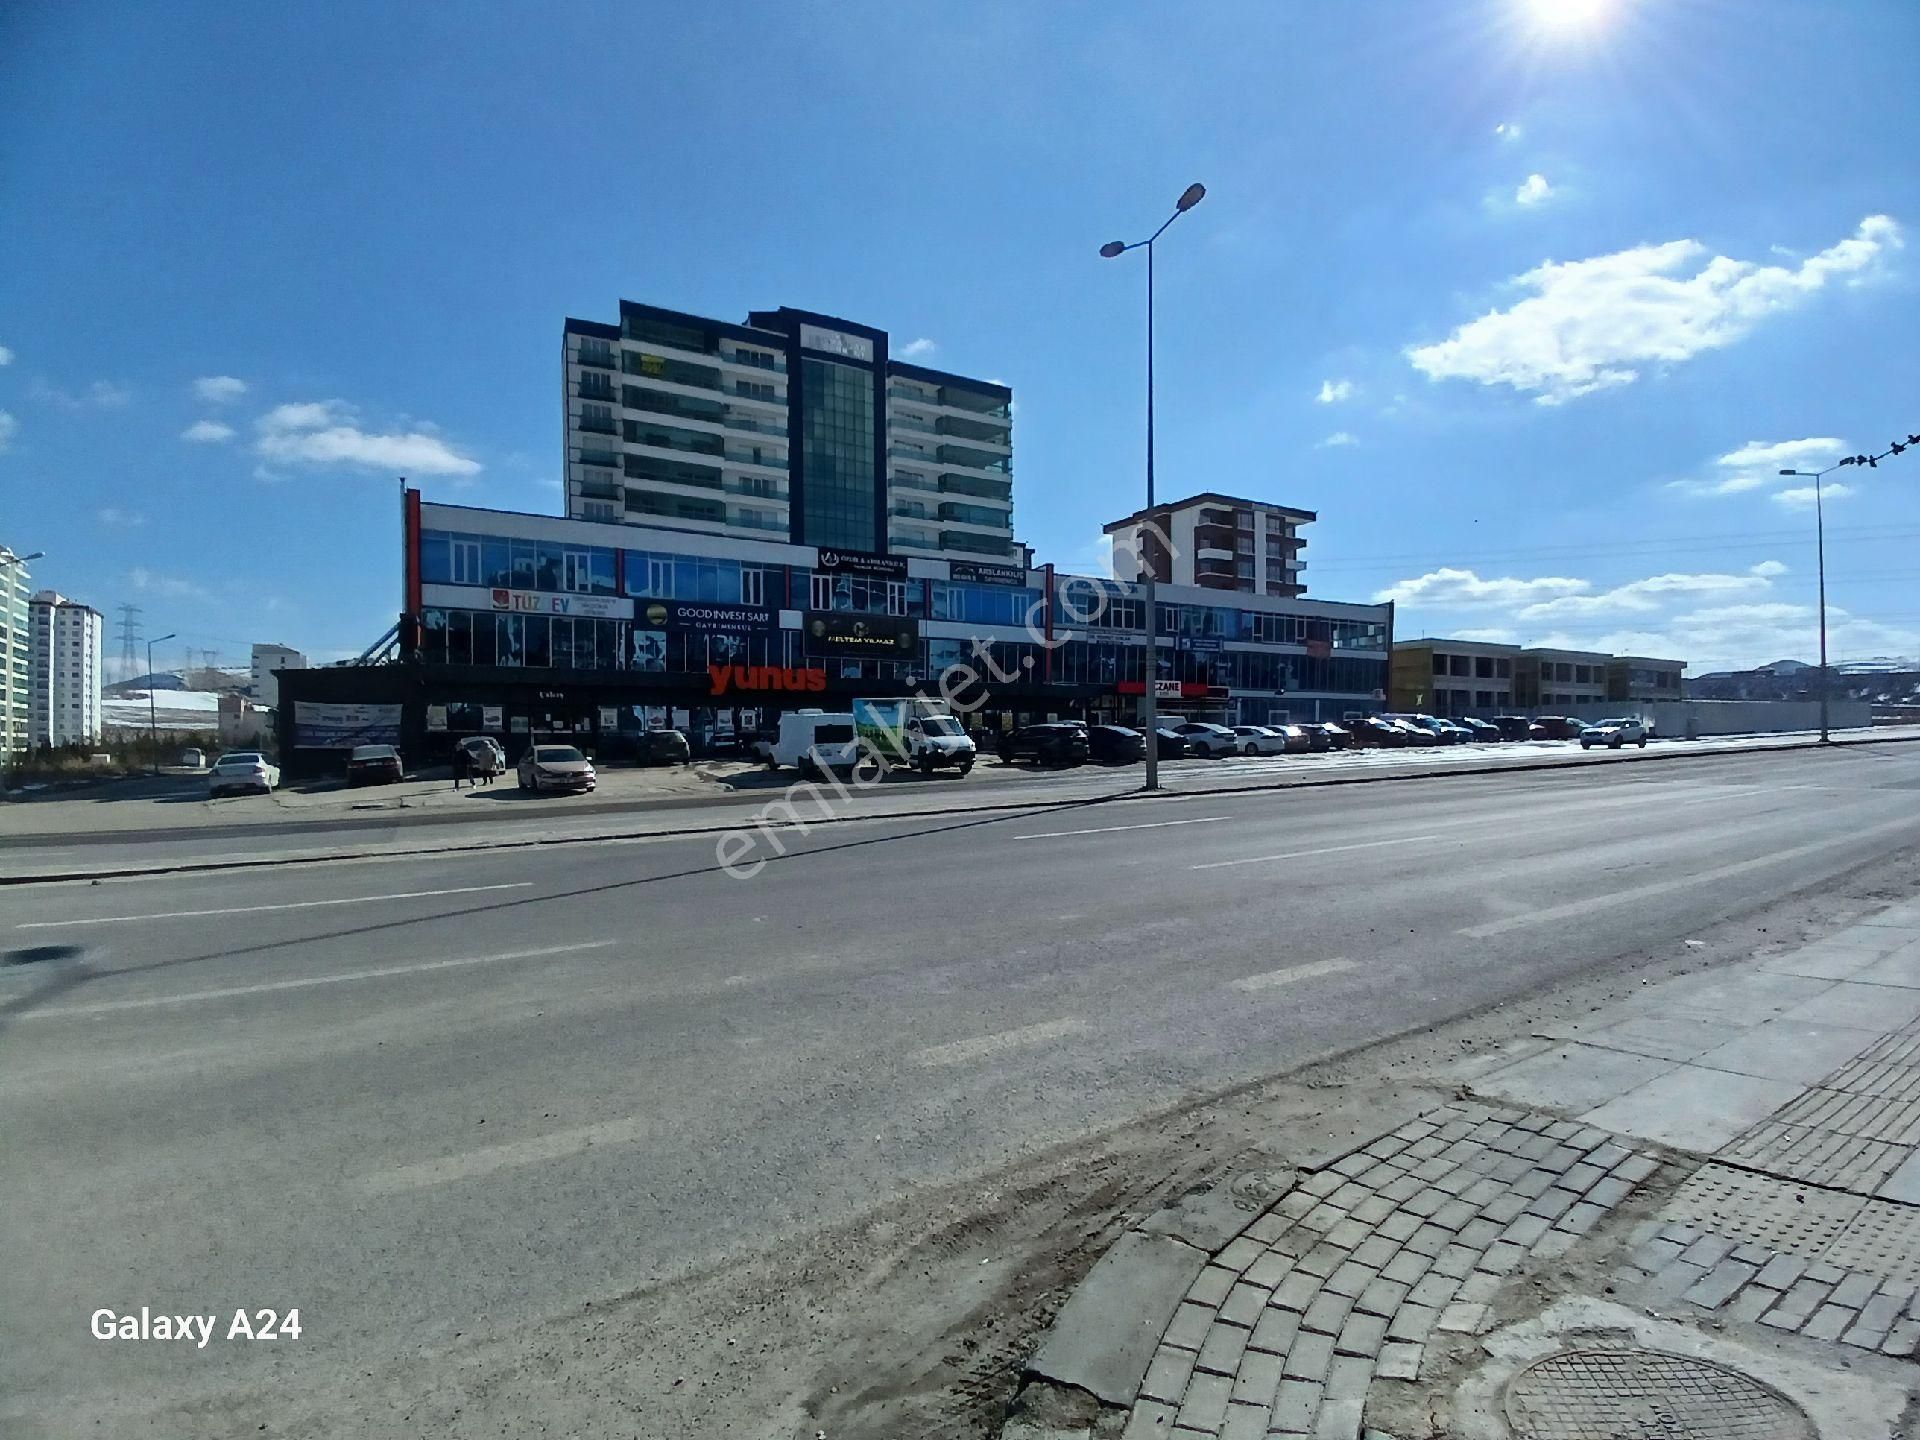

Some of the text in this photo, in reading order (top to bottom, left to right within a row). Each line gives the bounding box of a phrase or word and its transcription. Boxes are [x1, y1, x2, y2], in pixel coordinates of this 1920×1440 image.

[677, 607, 713, 619] GOOD
[713, 610, 746, 621] INVEST
[708, 664, 827, 696] yunus
